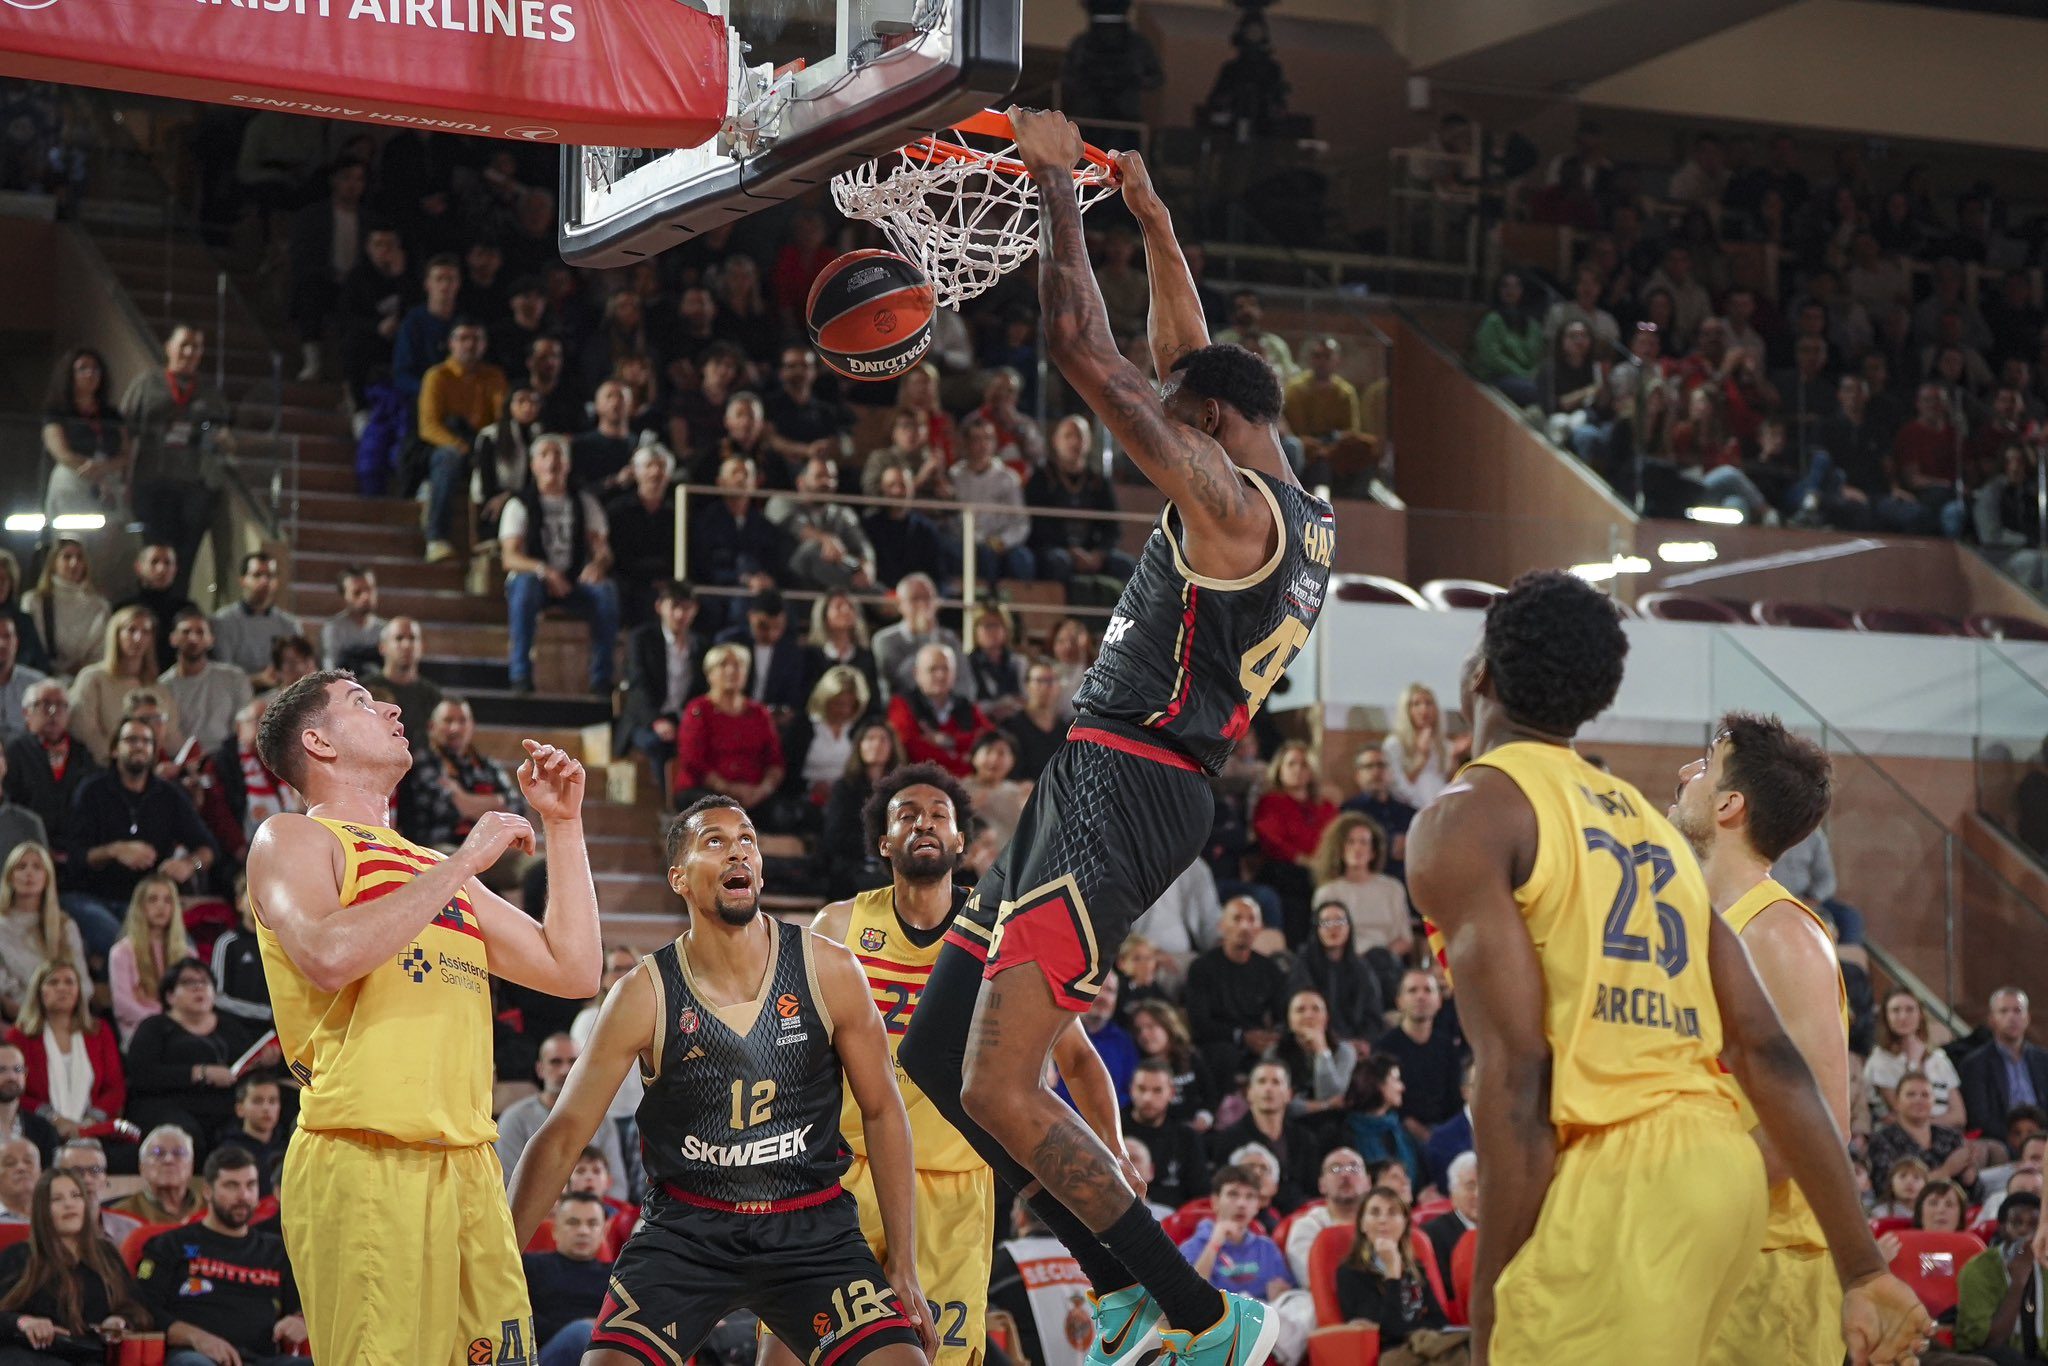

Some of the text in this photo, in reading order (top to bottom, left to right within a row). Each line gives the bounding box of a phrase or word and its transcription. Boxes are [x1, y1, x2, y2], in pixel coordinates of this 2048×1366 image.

[348, 0, 576, 43] AIRLINES
[229, 94, 492, 133] TURKISH AIRLINES
[847, 327, 932, 373] SPALDING
[729, 1079, 776, 1130] 12
[681, 1124, 814, 1167] SKWEEK
[831, 1279, 882, 1340] 12
